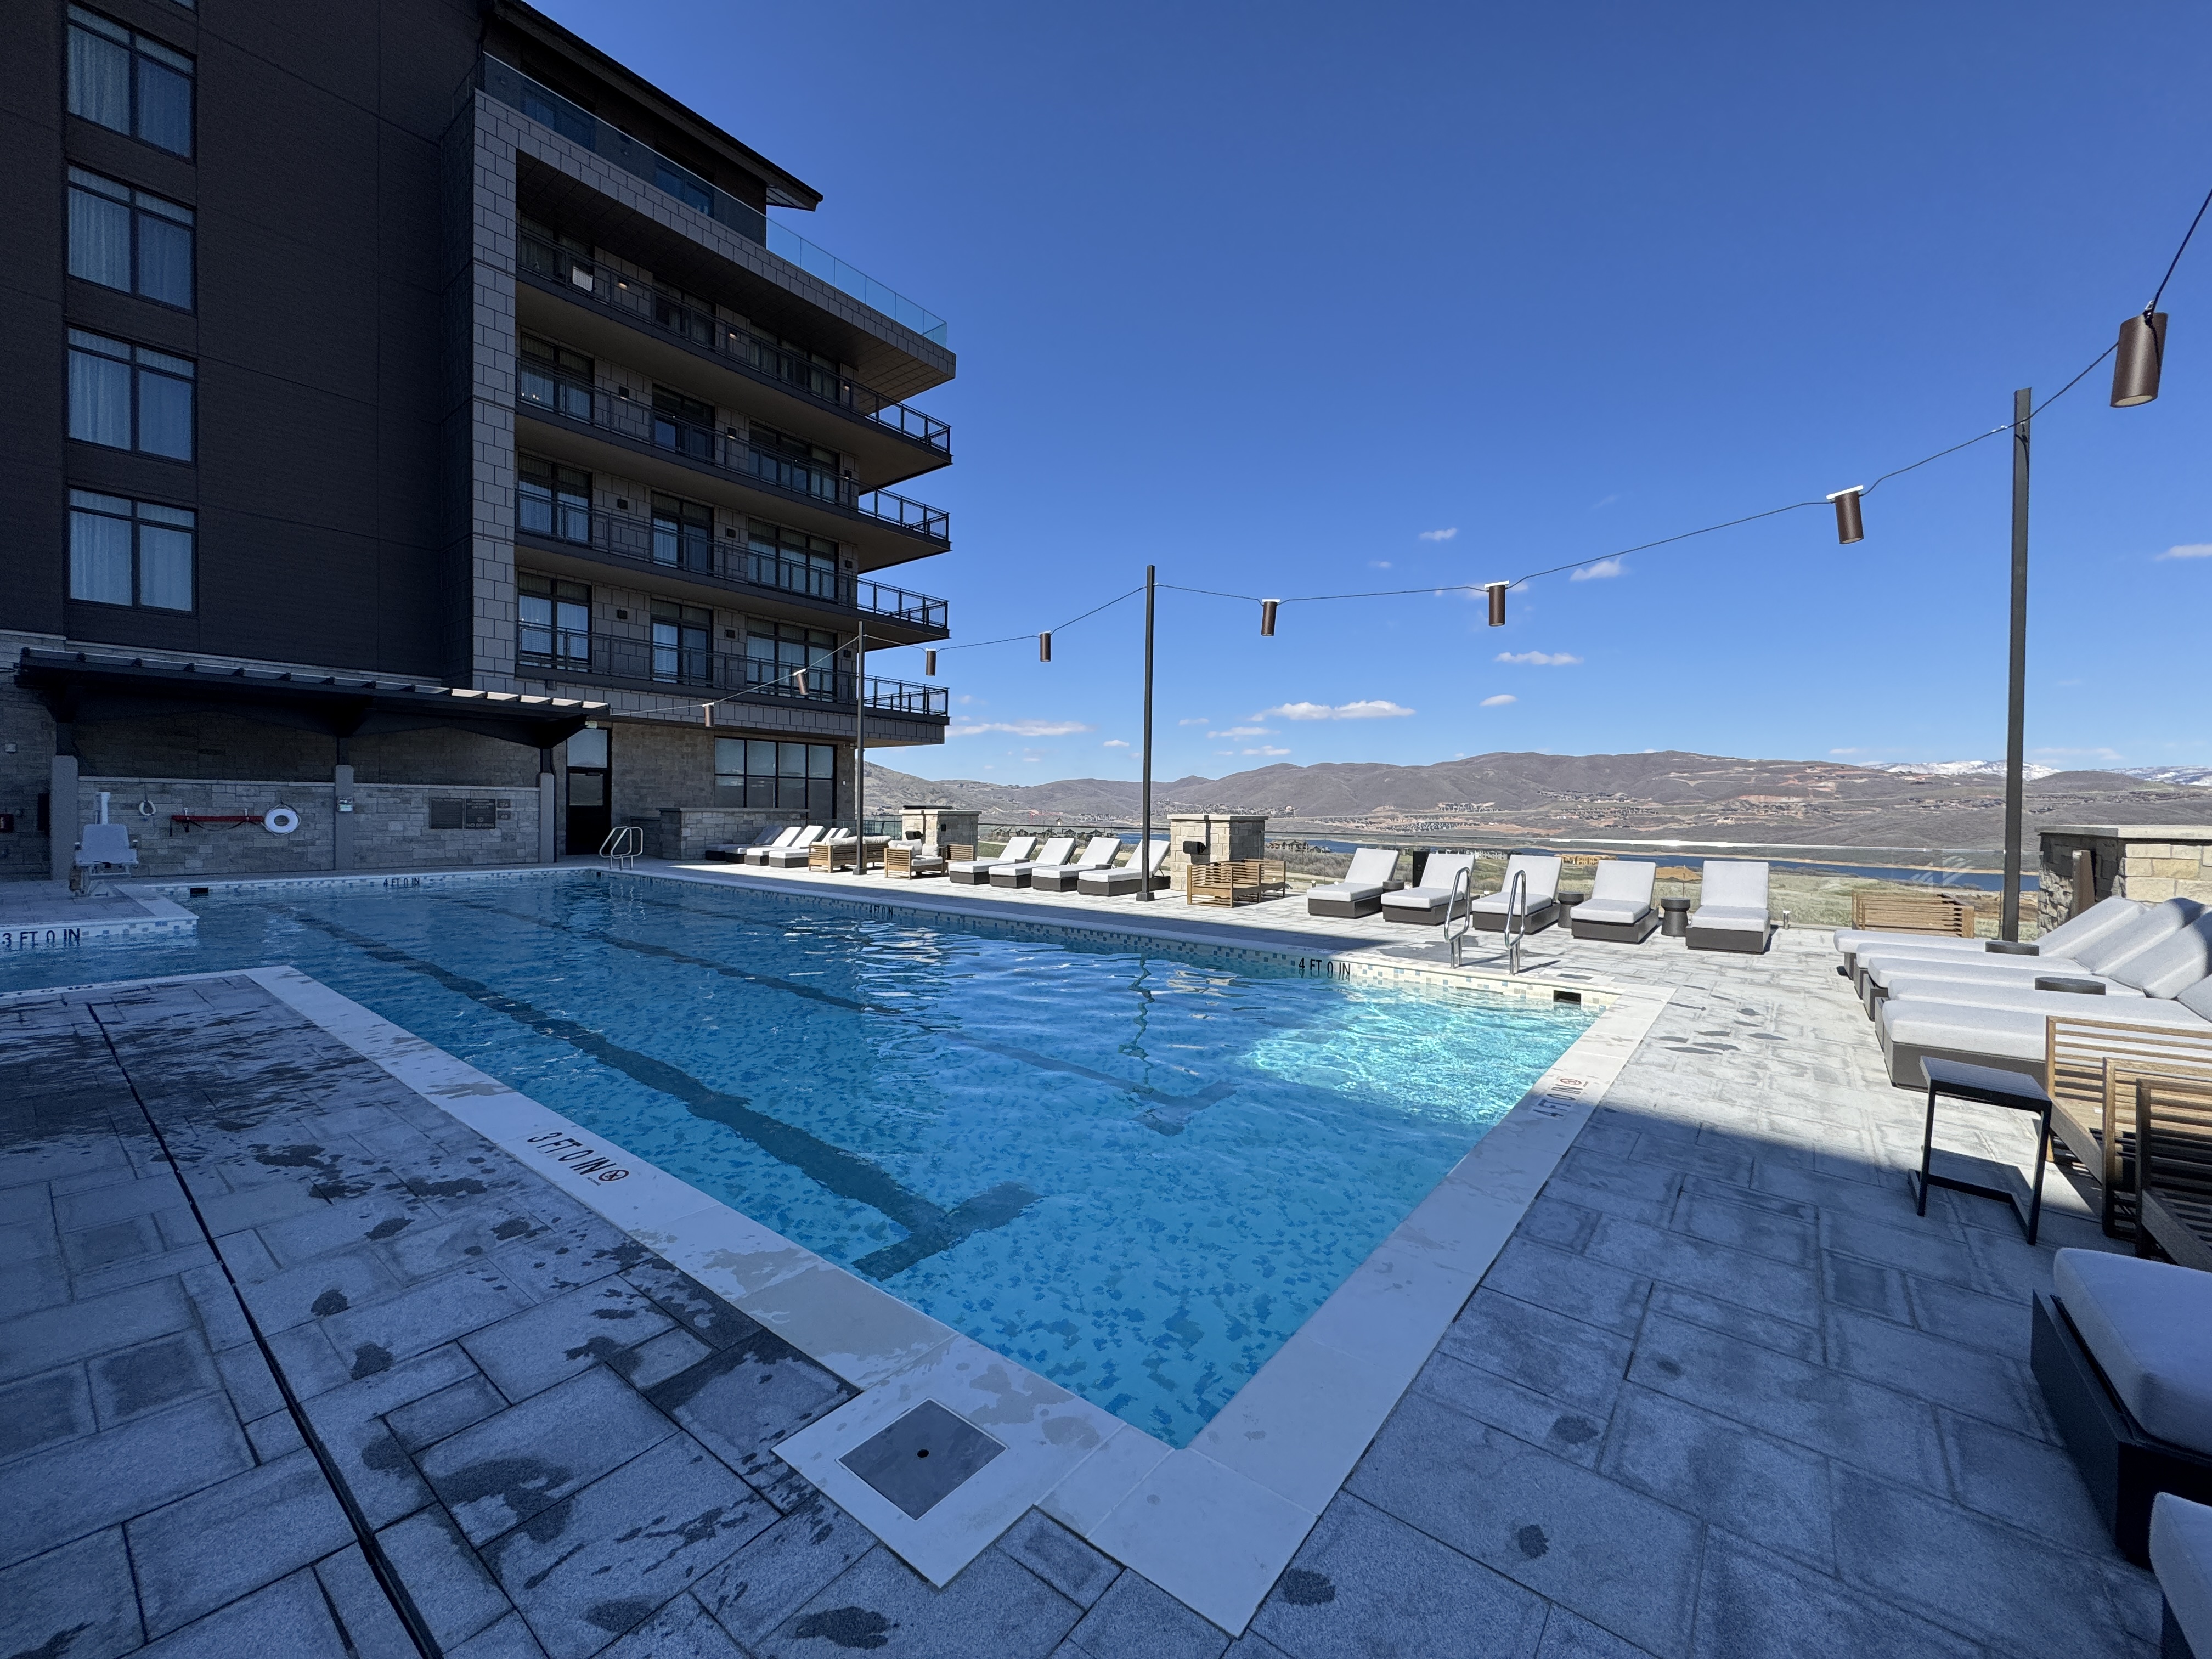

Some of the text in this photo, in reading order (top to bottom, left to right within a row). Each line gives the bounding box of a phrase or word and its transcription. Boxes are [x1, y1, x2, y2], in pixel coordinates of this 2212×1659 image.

[383, 878, 388, 887] 4
[392, 878, 400, 887] FT
[412, 877, 420, 887] IN
[887, 907, 893, 917] IN
[2, 933, 12, 947] 3
[20, 931, 38, 947] FT
[64, 928, 80, 946] IN
[1299, 958, 1351, 976] 4 FT 0 IN
[1551, 1084, 1584, 1095] IN
[1538, 1099, 1572, 1111] FT
[527, 1132, 617, 1175] 3 FT 0 IN
